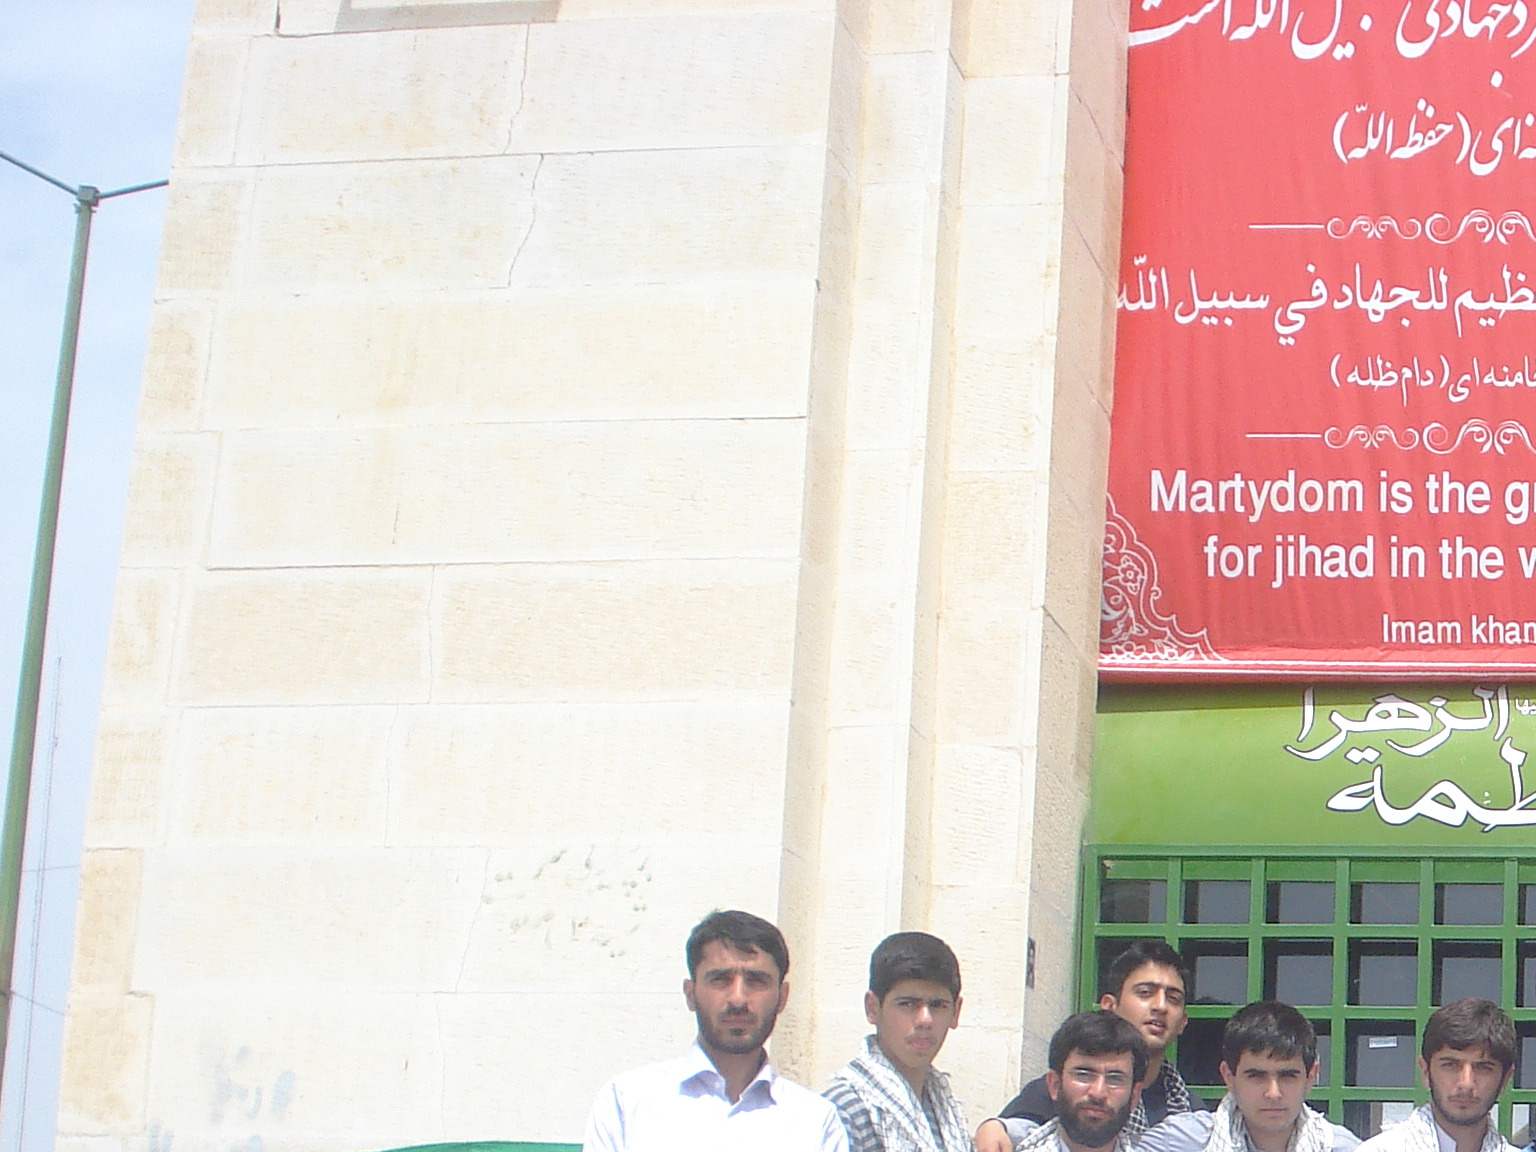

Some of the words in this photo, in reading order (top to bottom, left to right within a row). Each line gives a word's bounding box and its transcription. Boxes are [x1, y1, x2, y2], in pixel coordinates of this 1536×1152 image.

[1333, 263, 1448, 328] للجهاد
[1150, 469, 1365, 523] Martydom
[1379, 470, 1413, 514] is
[1425, 471, 1491, 515] the
[1203, 535, 1263, 578] for
[1271, 534, 1374, 588] jihad
[1390, 535, 1426, 578] in
[1438, 536, 1505, 580] the
[1383, 613, 1462, 644] Imam
